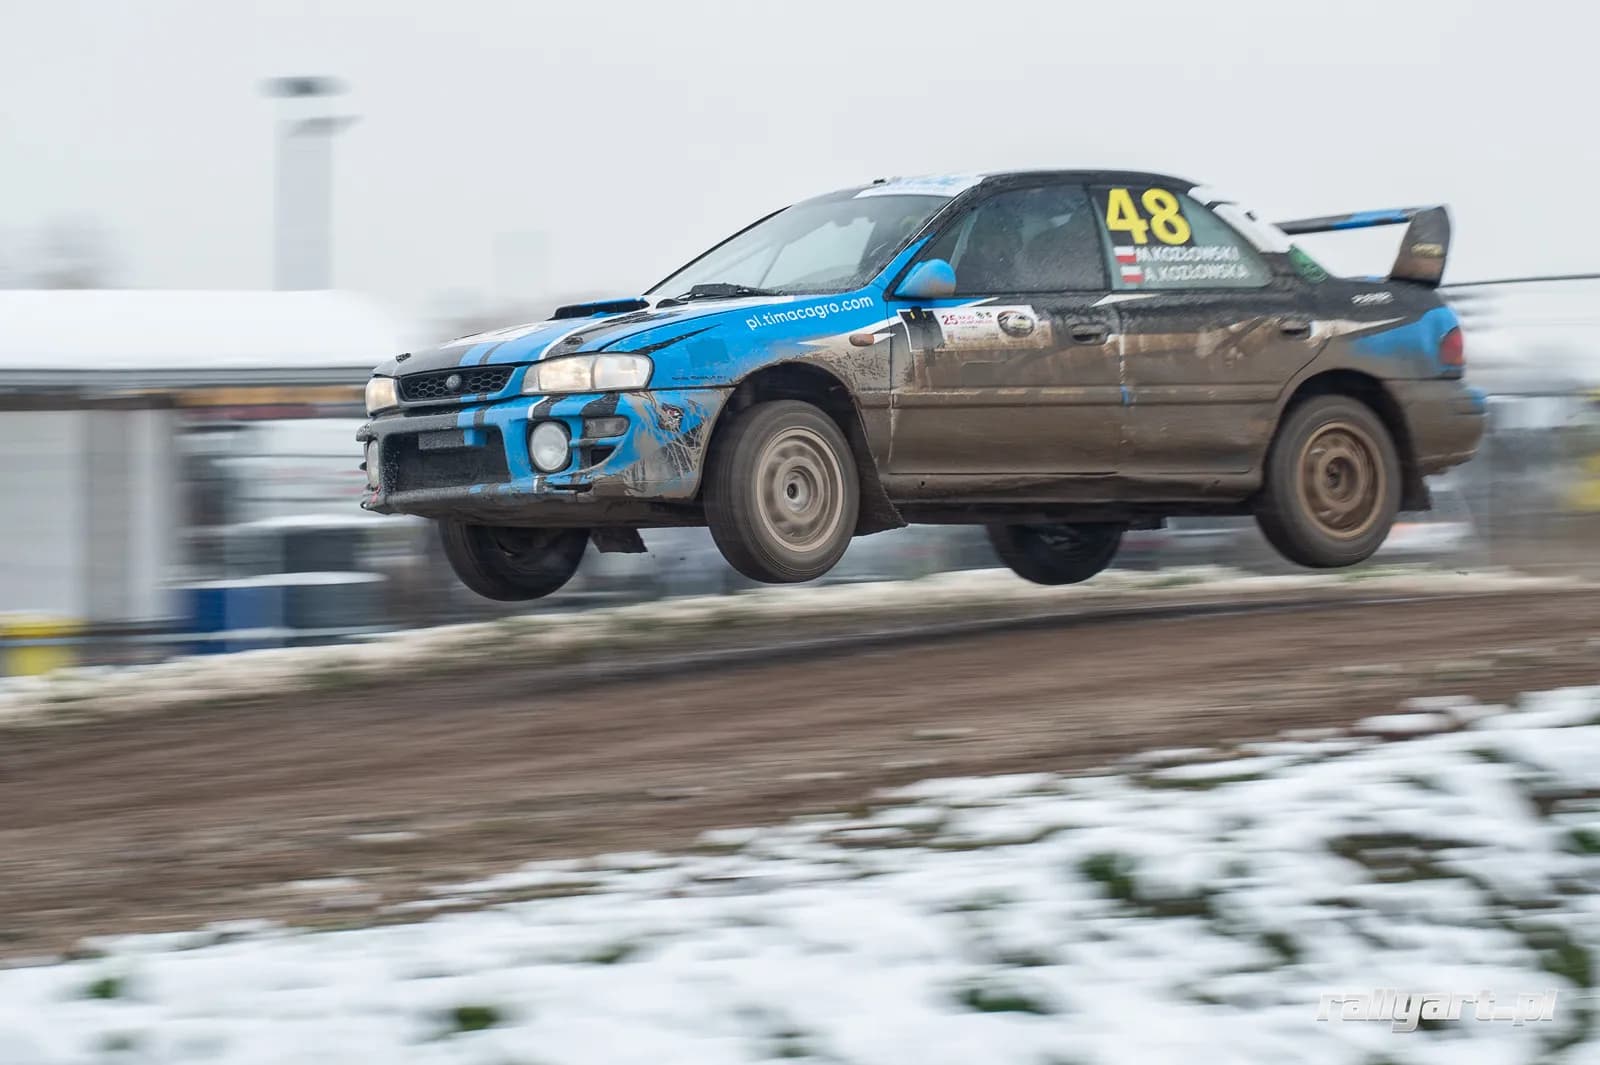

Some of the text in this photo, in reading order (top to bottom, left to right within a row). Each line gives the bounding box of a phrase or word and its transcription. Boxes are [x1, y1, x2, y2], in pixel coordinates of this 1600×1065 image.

[1106, 188, 1191, 245] 48
[745, 296, 874, 331] pl.timacagro.com
[941, 314, 959, 326] 25
